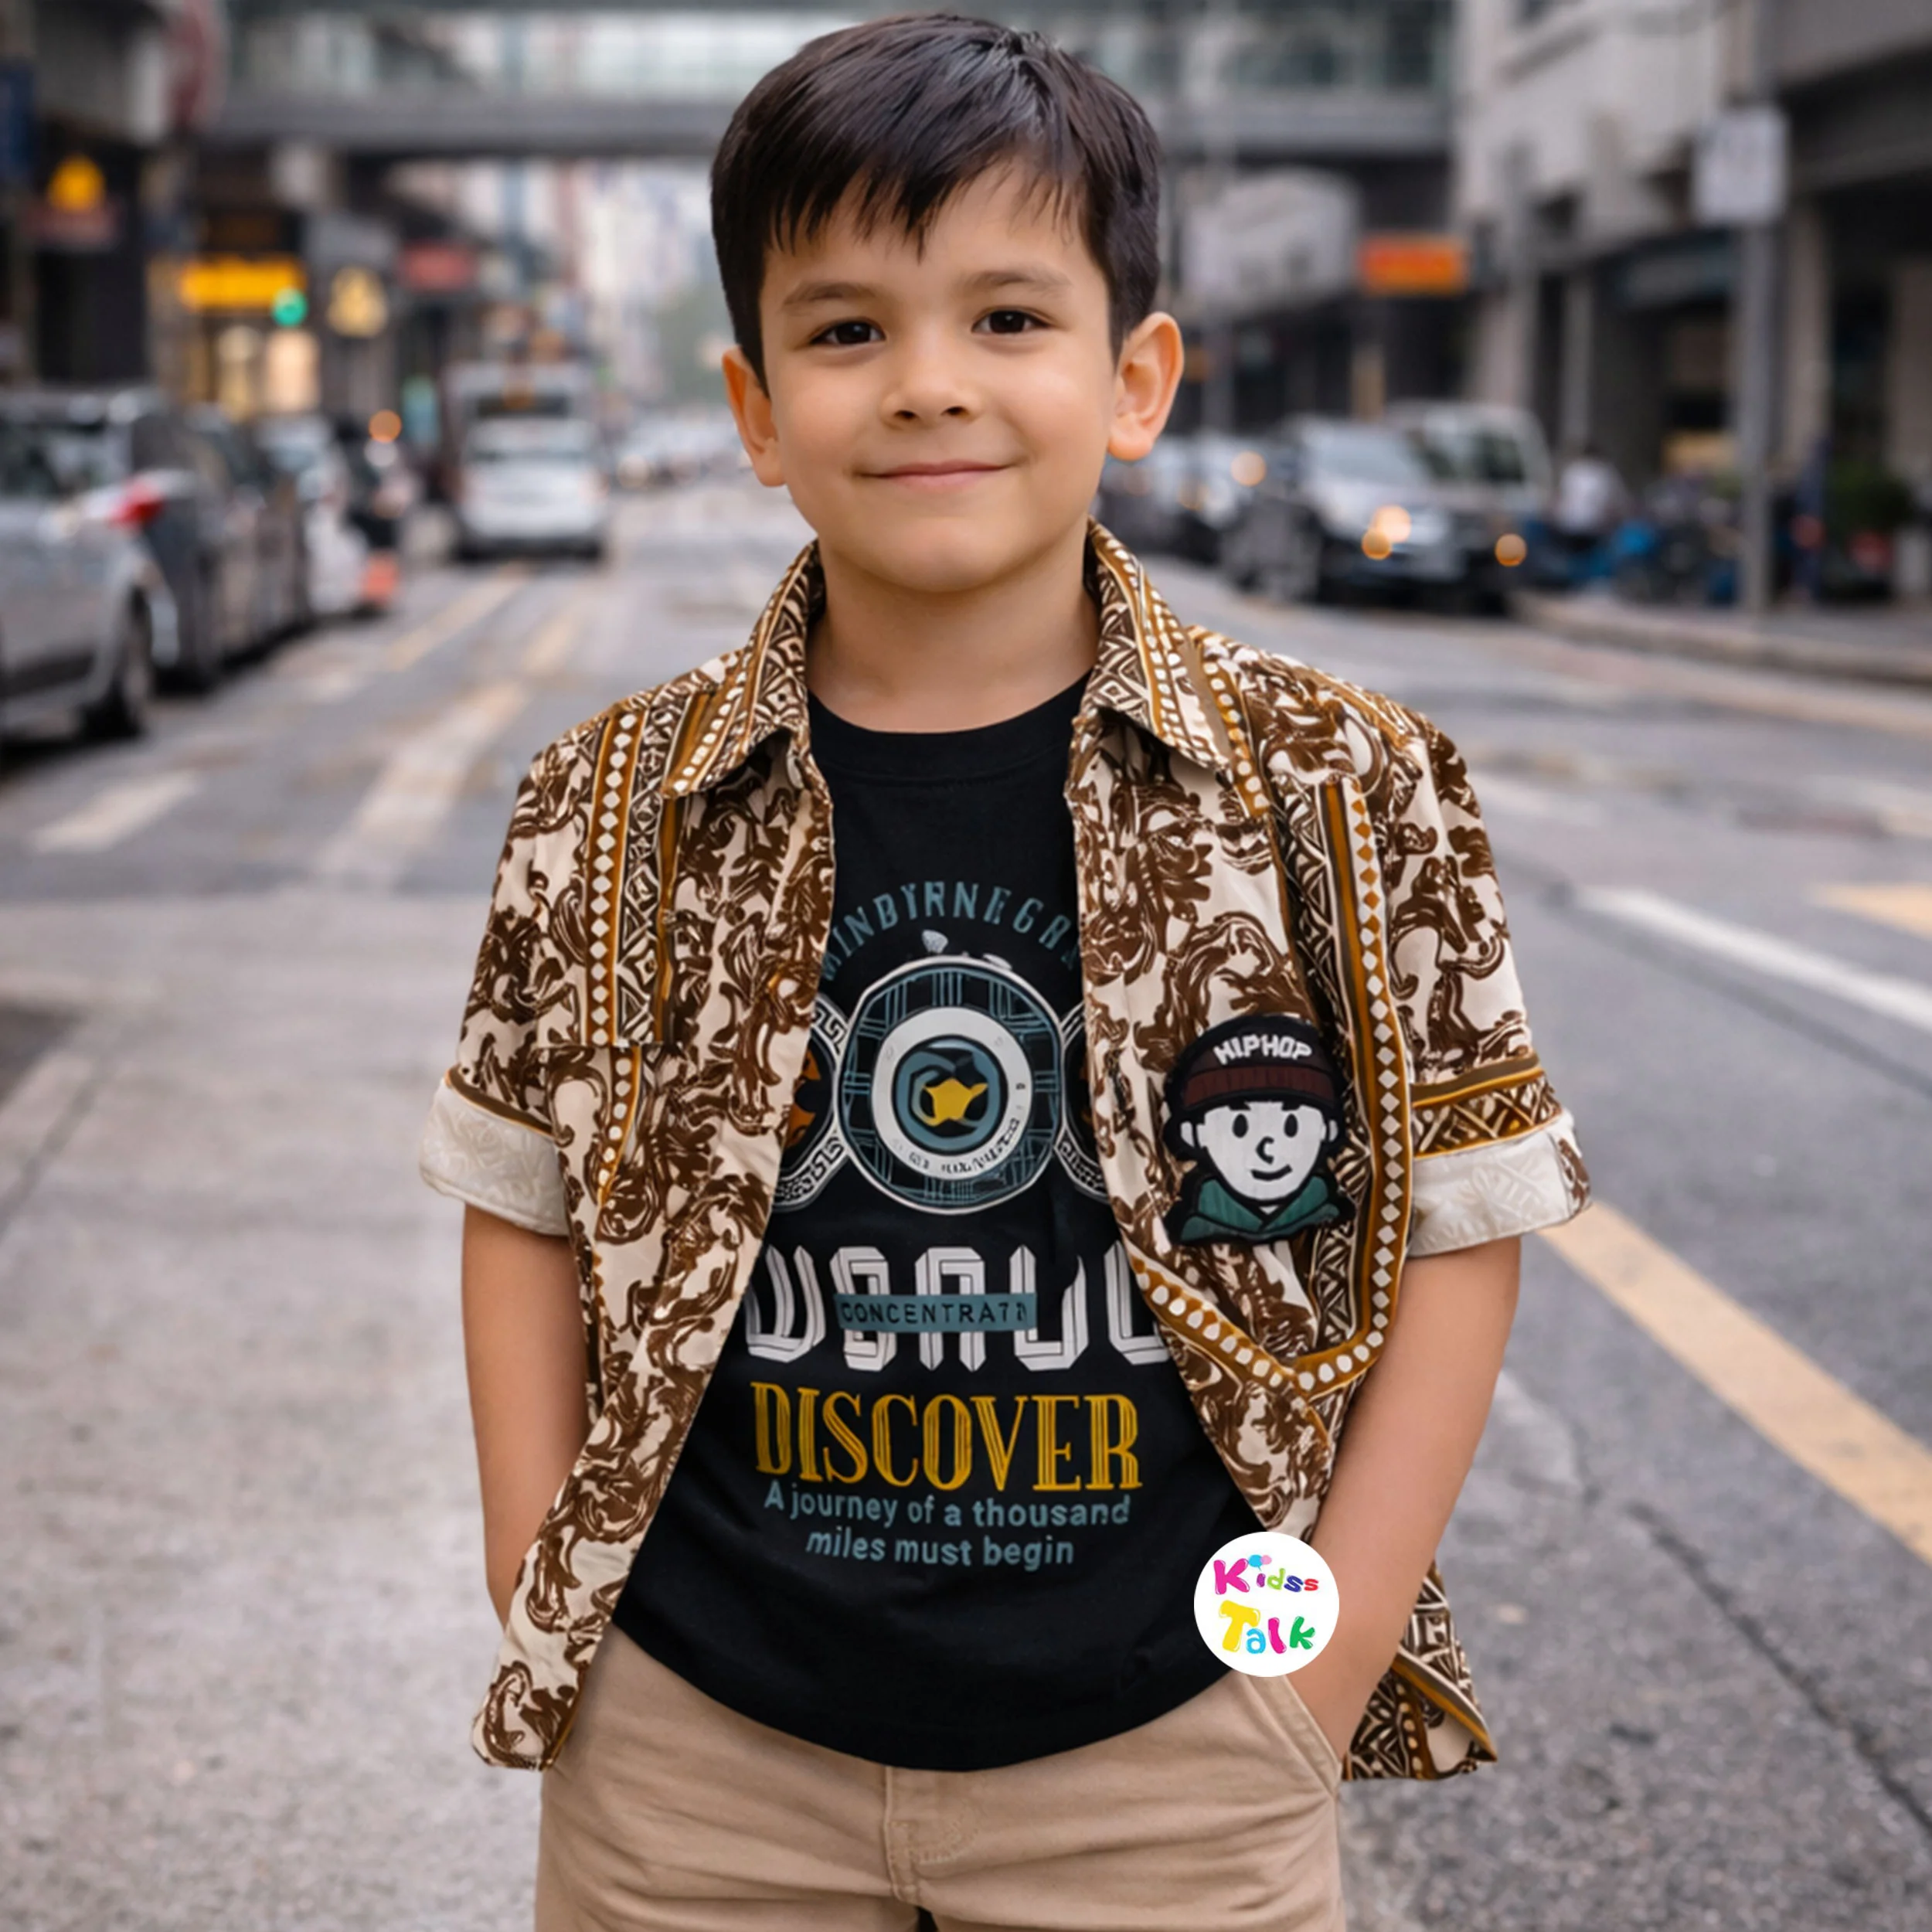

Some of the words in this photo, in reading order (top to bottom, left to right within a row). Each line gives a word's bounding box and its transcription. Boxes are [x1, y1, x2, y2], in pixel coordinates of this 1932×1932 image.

[1213, 1033, 1312, 1065] HIPHOP
[750, 1381, 1142, 1492] DISCOVER
[764, 1479, 784, 1510] A
[790, 1483, 897, 1529] journey
[907, 1495, 935, 1525] of
[944, 1503, 962, 1527] a
[972, 1494, 1131, 1528] thousand
[805, 1526, 886, 1562] miles
[894, 1539, 972, 1566] must
[983, 1535, 1074, 1572] begin
